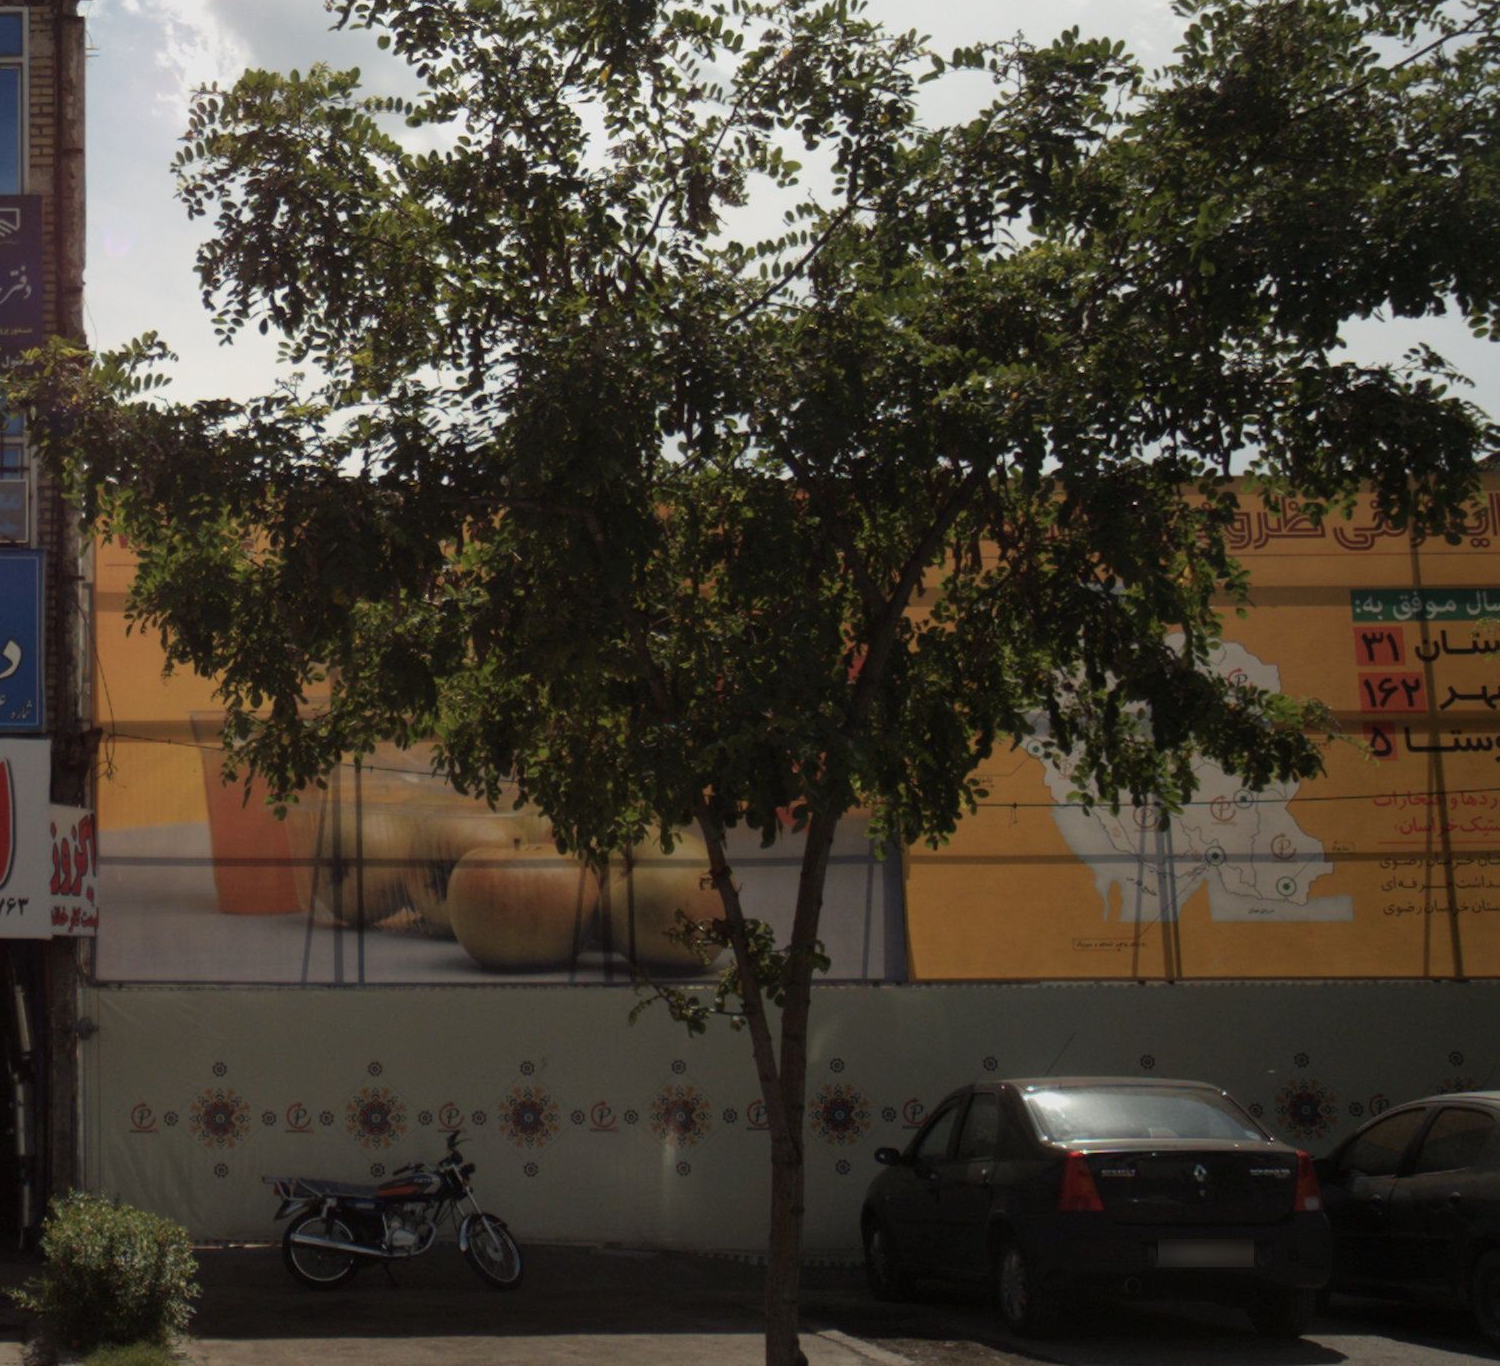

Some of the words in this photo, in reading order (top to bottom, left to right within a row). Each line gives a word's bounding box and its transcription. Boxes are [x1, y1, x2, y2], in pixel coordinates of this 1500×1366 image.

[1392, 590, 1457, 621] موفق
[1362, 631, 1400, 663] ۳۱
[1363, 677, 1421, 709] ۱۶۲
[1370, 725, 1393, 757] ۵
[49, 813, 98, 897] اگزوز
